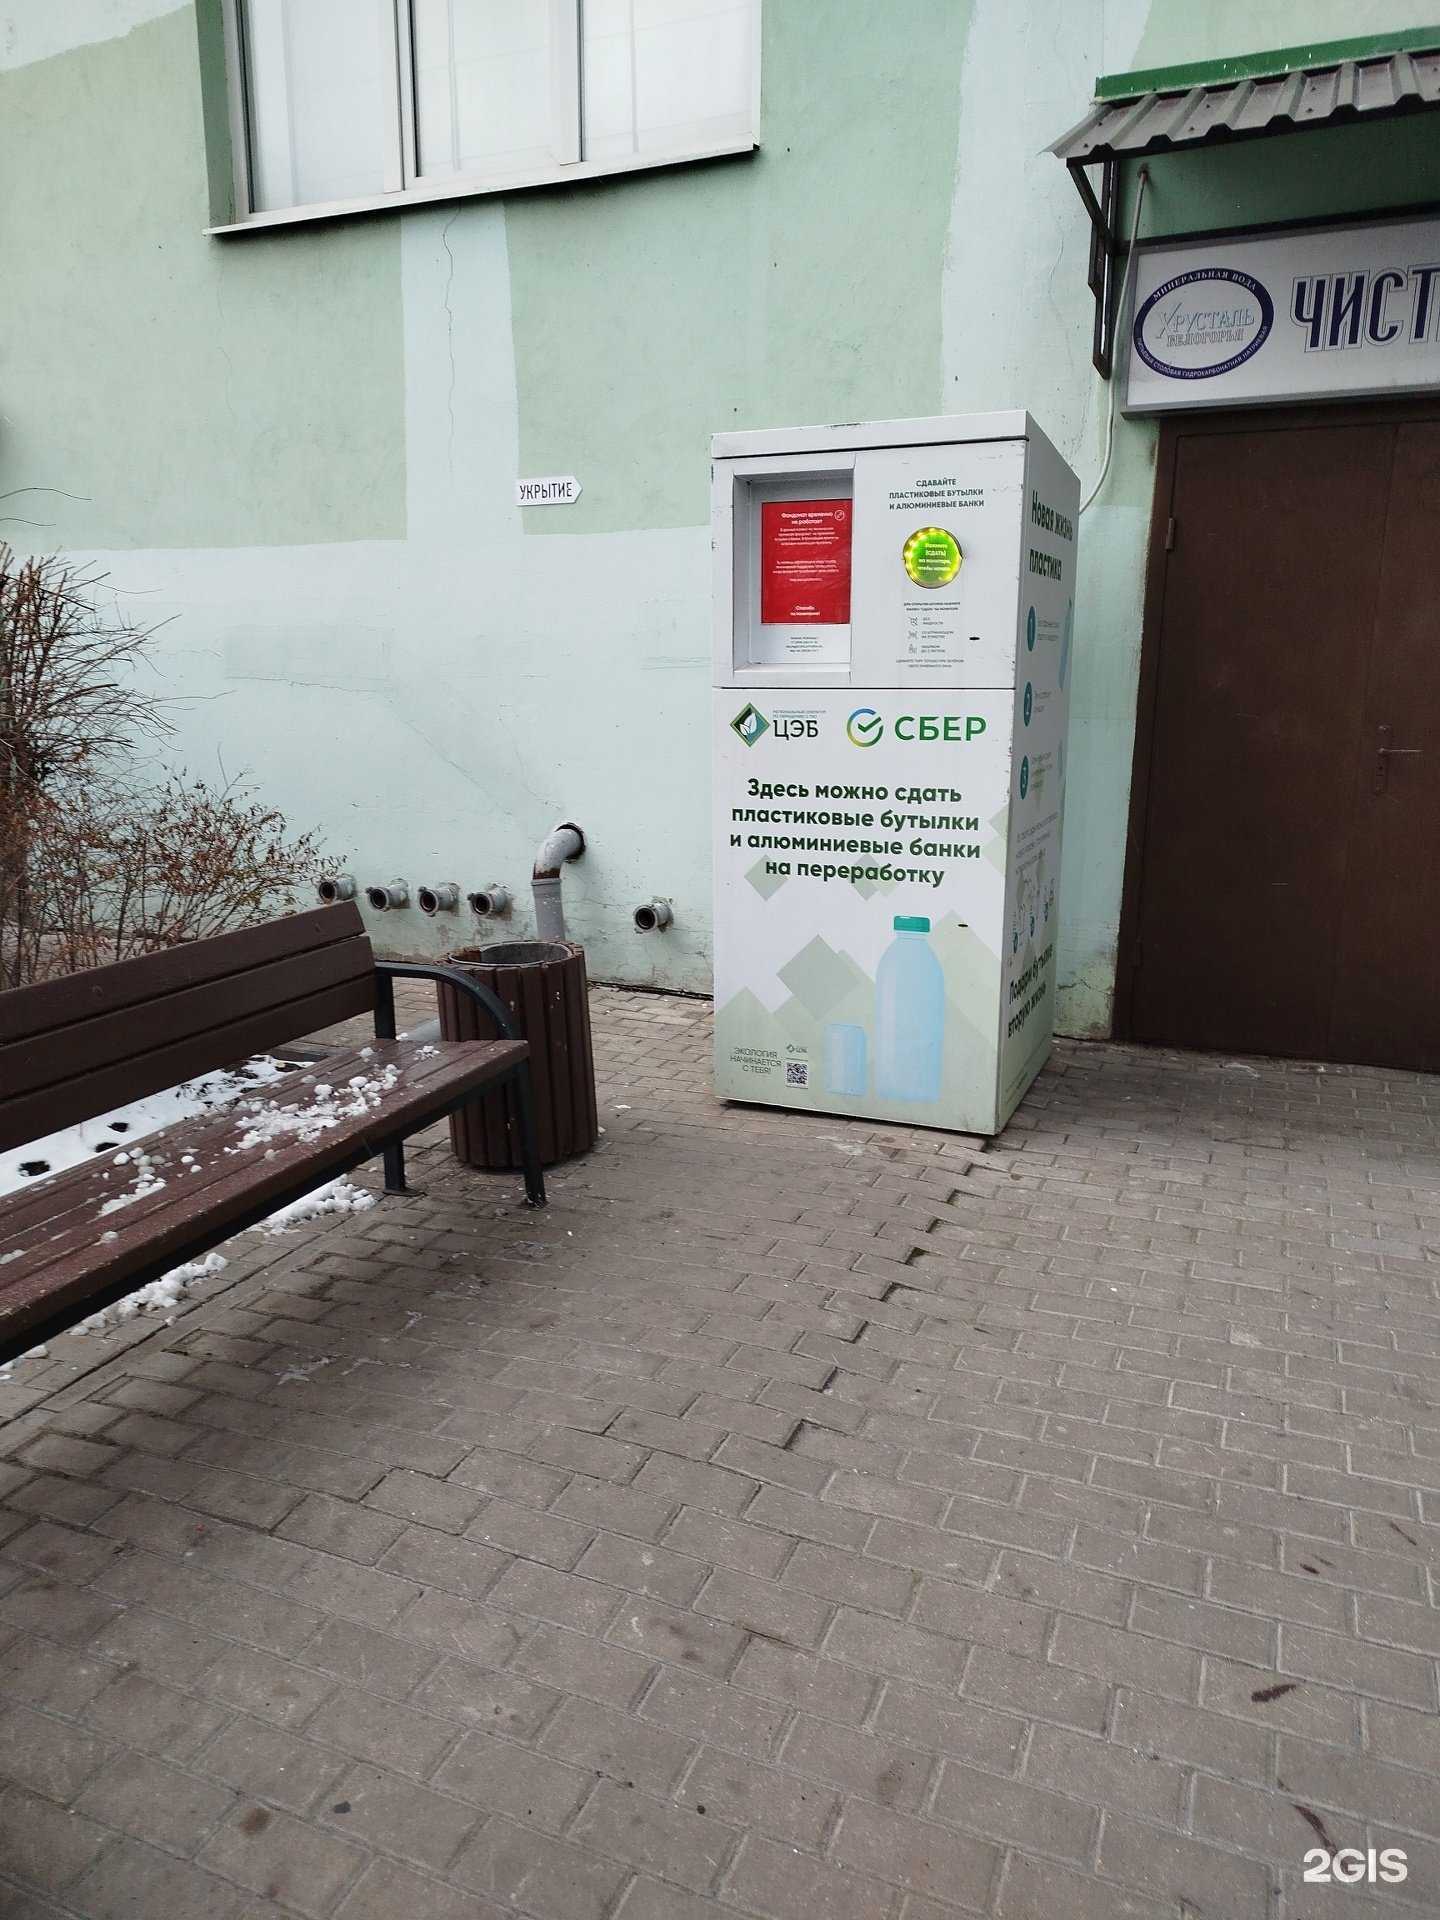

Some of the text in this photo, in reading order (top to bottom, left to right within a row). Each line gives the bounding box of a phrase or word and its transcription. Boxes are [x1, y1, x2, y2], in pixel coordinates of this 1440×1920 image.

[1153, 271, 1256, 301] МИНЕРАЛЬНАЯ ВОДА
[1290, 262, 1440, 353] ЧИСТ
[519, 482, 572, 500] УКРЫТИЕ
[889, 489, 984, 499] ПЛАСТИКОВЫЕ БУТЫЛКИ
[916, 478, 957, 488] СДАВАЙТЕ
[896, 501, 957, 510] АЛЮМИНИЕВЫЕ
[958, 500, 984, 508] БАНКИ
[1031, 490, 1054, 532] Новая
[1029, 548, 1062, 581] пластика
[773, 719, 819, 741] ЦЭБ
[895, 716, 987, 741] СБЕР
[747, 778, 962, 804] Здесь можно сдать
[732, 807, 979, 832] пластиковые бутылки
[730, 834, 981, 858] и алюминиевые банки
[765, 861, 945, 888] на переработку
[730, 1055, 781, 1067] НАЧИНАЕТСЯ
[734, 1047, 777, 1058] ЭКОЛОГИЯ
[742, 1064, 749, 1072] С
